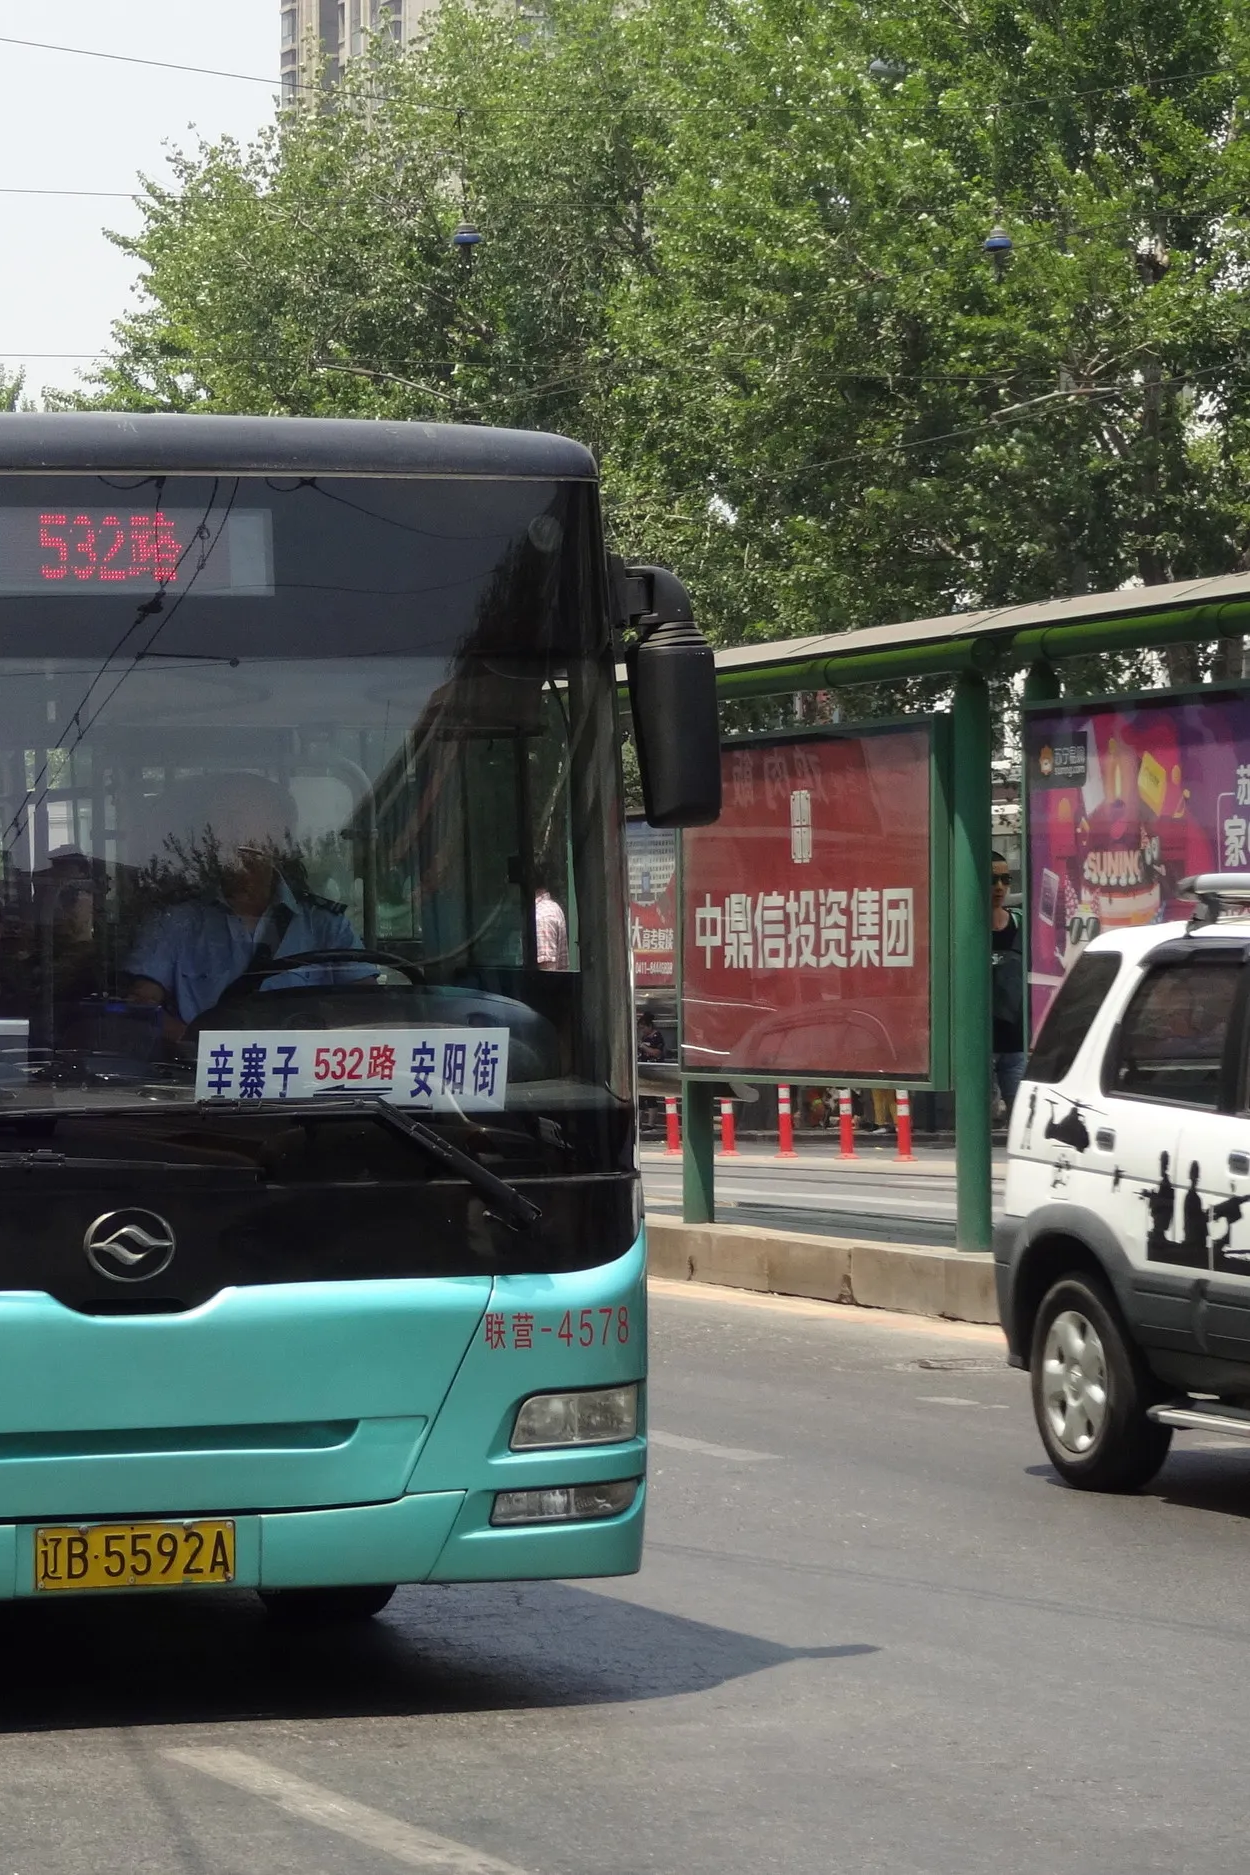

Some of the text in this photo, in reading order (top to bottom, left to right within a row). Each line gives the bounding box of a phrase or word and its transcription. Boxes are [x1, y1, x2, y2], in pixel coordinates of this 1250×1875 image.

[39, 511, 182, 581] 532路
[694, 887, 914, 969] 中鼎信投资集团
[207, 1040, 499, 1098] 辛寨子 532路 安阳街
[484, 1306, 629, 1350] 联营-4578
